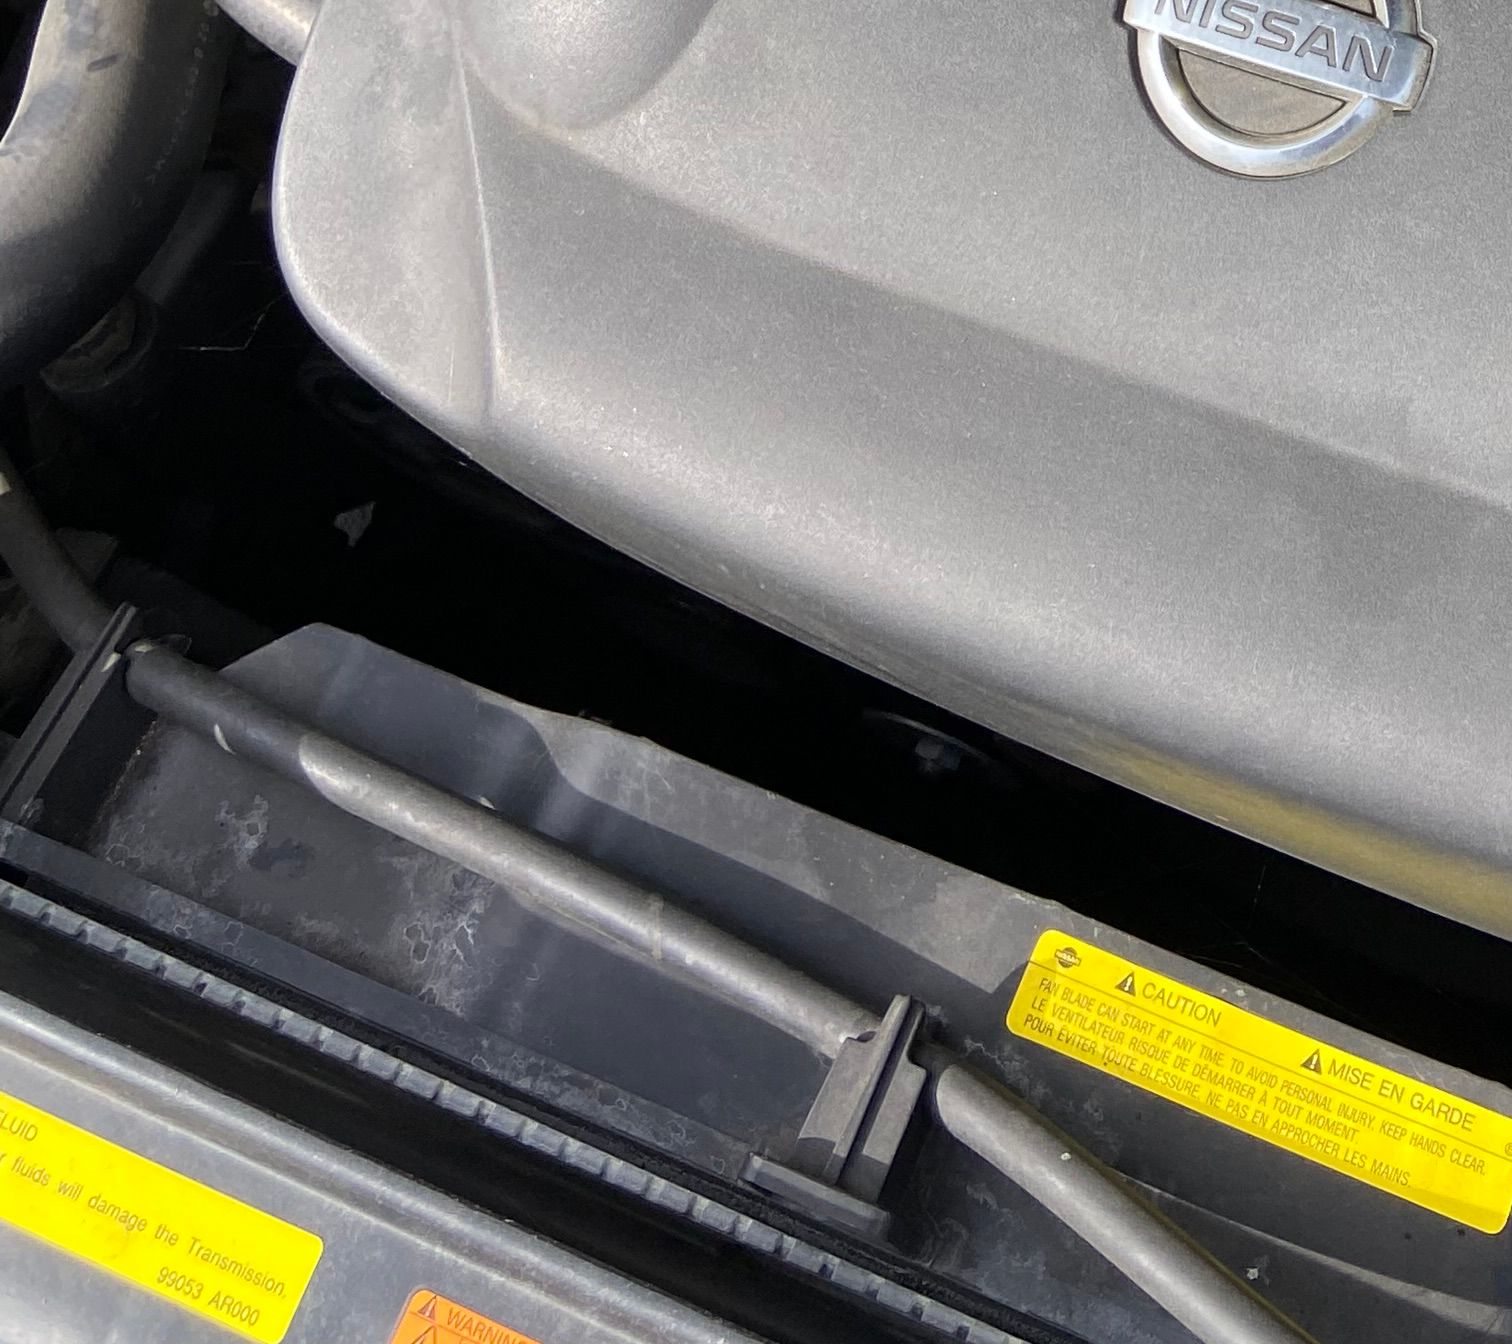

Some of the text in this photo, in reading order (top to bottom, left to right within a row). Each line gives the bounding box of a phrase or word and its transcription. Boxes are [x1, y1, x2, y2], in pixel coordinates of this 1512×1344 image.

[1142, 982, 1222, 1027] CAUTION
[1032, 996, 1048, 1012] LE
[1051, 1003, 1125, 1045] VENTILATEUR
[1128, 1036, 1172, 1065] RISQUE
[1173, 1055, 1192, 1073] DE
[1193, 1060, 1255, 1100] DÉMARRER
[1258, 1088, 1269, 1107] À
[1272, 1096, 1304, 1120] TOUT
[1039, 977, 1057, 993] FAN
[1061, 985, 1096, 1012] BLADE
[1100, 1003, 1120, 1023] CAN
[1121, 1012, 1156, 1036] START
[1157, 1026, 1172, 1043] AT
[1172, 1036, 1197, 1055] ANY
[1230, 1057, 1245, 1076] TO
[1245, 1066, 1279, 1089] AVOID
[1280, 1079, 1333, 1113] PERSONAL
[1380, 1119, 1407, 1141] KEEP
[1409, 1131, 1447, 1158] HANDS
[1450, 1148, 1486, 1176] CLEAR.
[1327, 1058, 1476, 1132] MISE EN GARDE
[1023, 1015, 1055, 1036] POUR
[1057, 1023, 1098, 1055] ÉVITER
[1102, 1045, 1139, 1073] TOUTE
[1206, 1090, 1222, 1109] NE
[1225, 1098, 1250, 1120] PAS
[1251, 1110, 1270, 1128] EN
[1271, 1119, 1342, 1162] APPROCHER
[1344, 1146, 1368, 1169] LES
[1370, 1159, 1412, 1188] MAINS.
[11, 1155, 51, 1187] fluids
[57, 1180, 84, 1201] will
[88, 1194, 148, 1232] damage
[154, 1223, 179, 1247] the
[156, 1266, 261, 1327] 99053 AR000
[446, 1308, 527, 1344] WARNIN
